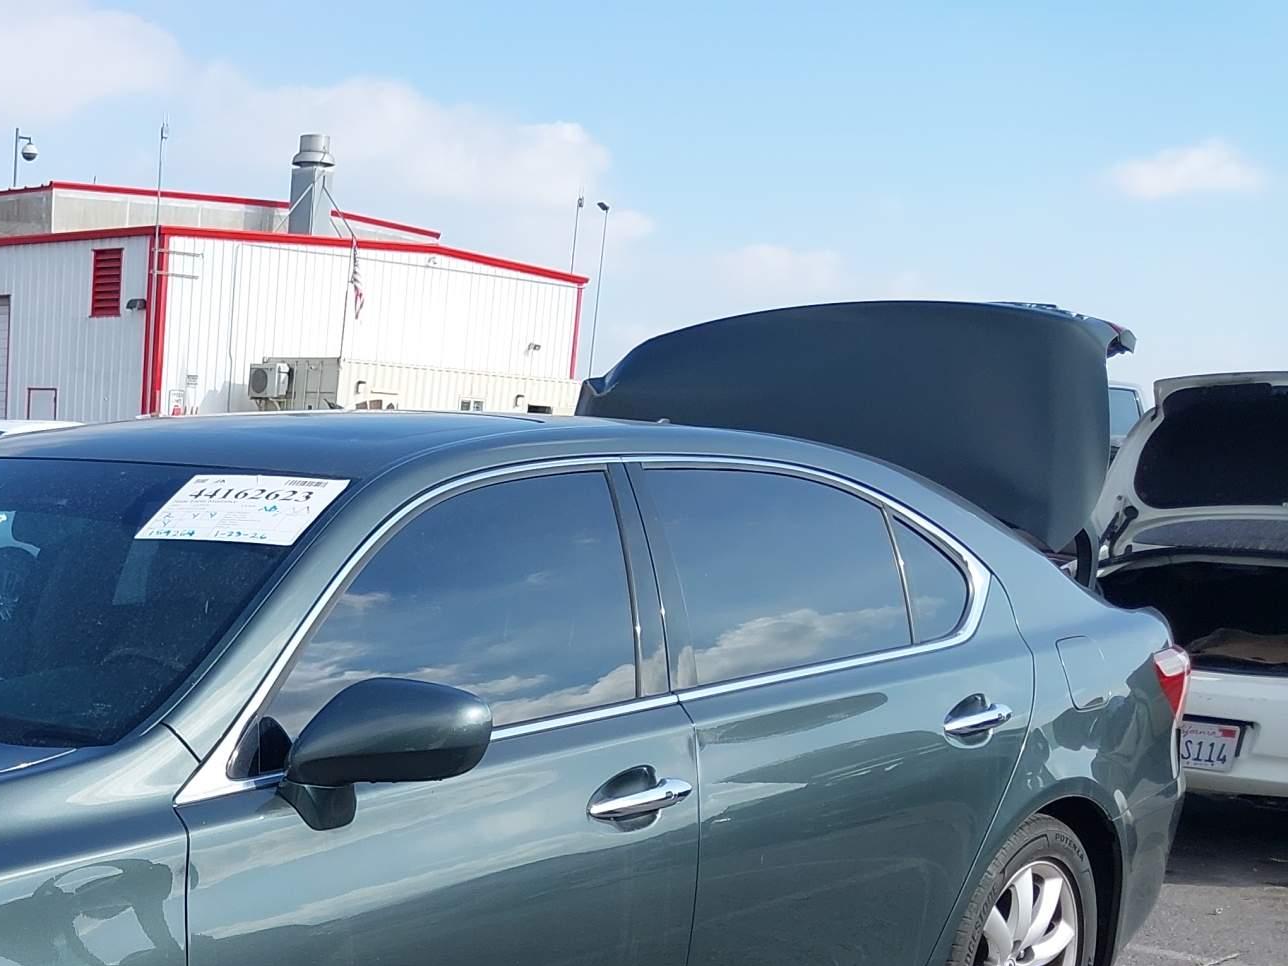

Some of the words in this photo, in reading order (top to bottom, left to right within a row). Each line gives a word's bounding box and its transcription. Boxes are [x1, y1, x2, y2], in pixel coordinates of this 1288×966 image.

[188, 487, 315, 503] 44162623
[1181, 740, 1227, 764] S114
[1055, 832, 1084, 862] POTENZA
